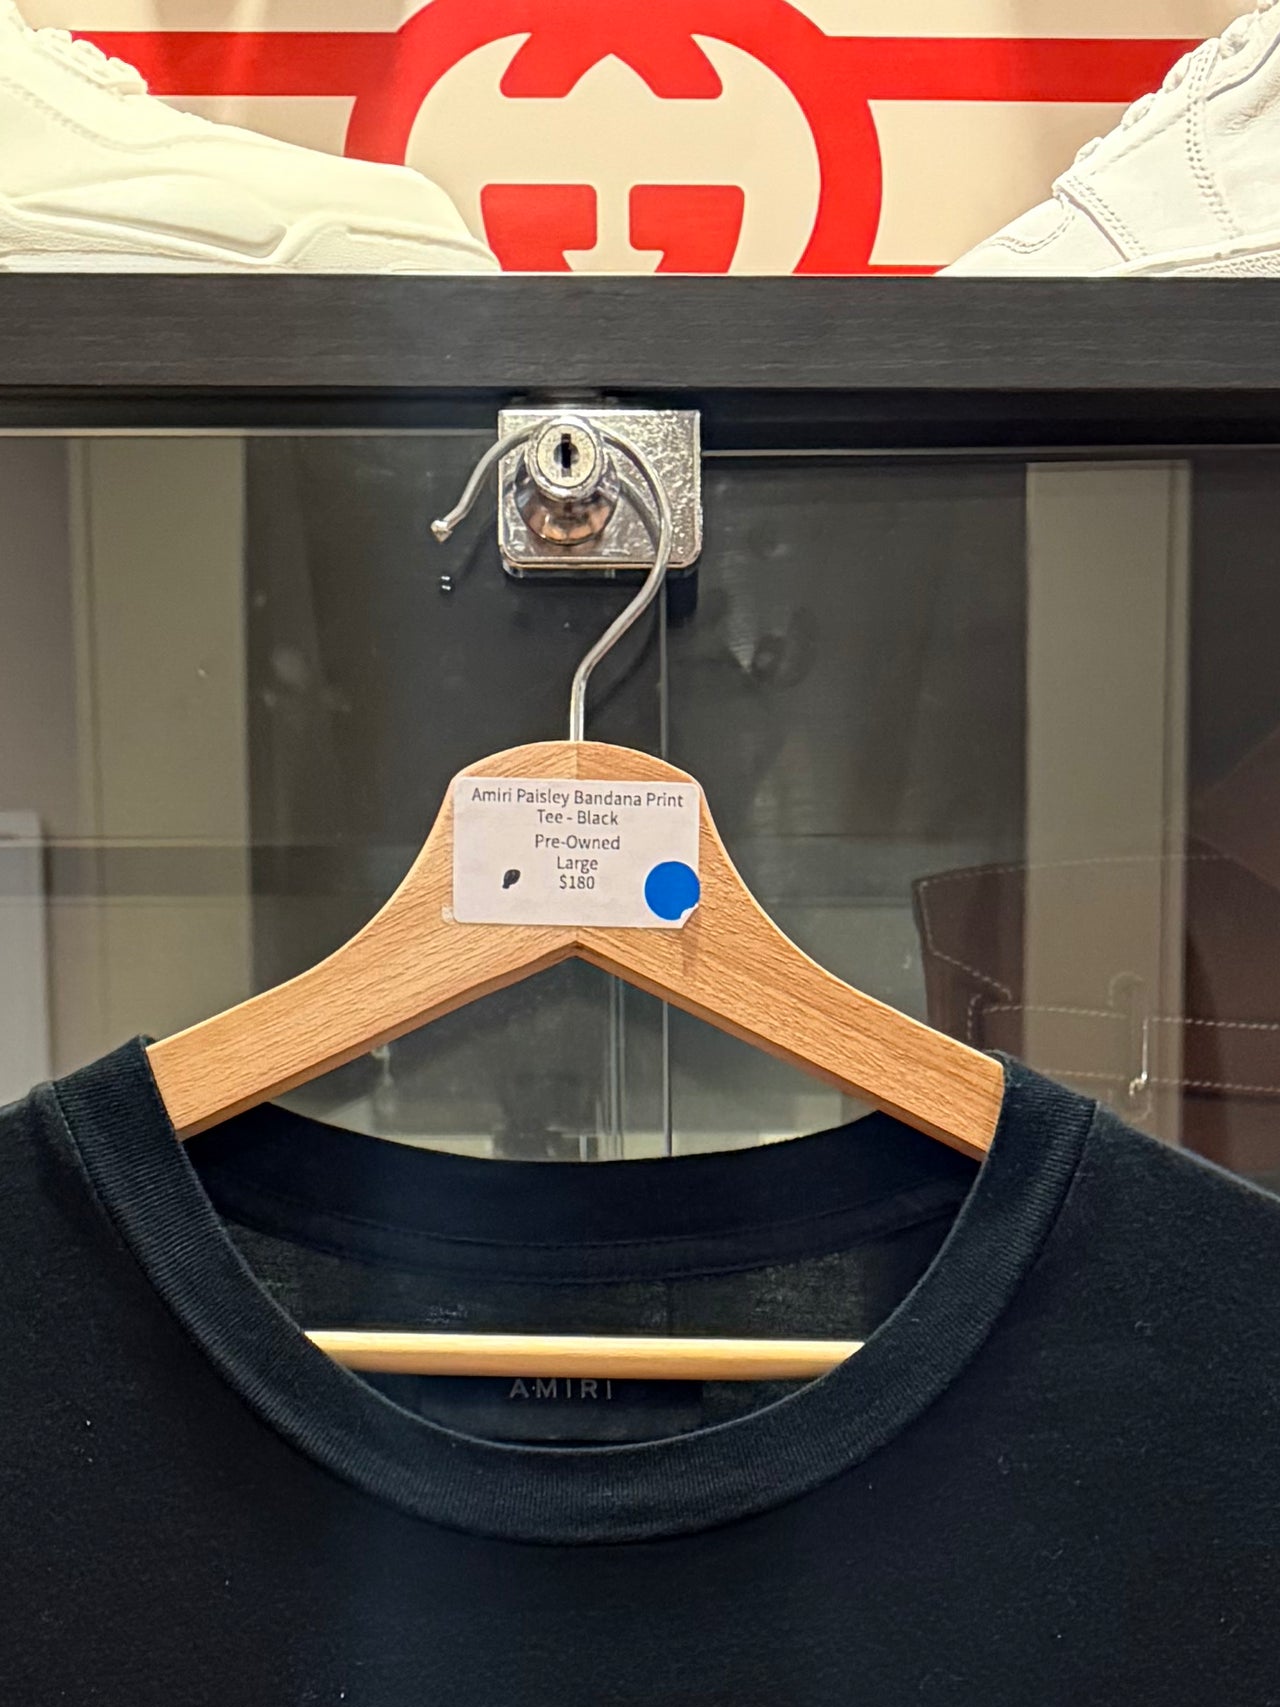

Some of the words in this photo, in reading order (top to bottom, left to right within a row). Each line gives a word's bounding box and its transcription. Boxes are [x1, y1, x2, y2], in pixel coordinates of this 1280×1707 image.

[471, 787, 512, 803] Amiri
[516, 788, 569, 809] Paisley
[573, 790, 642, 807] Bandana
[646, 792, 684, 808] Print
[536, 809, 564, 824] Tee
[577, 810, 619, 826] Black
[535, 833, 621, 850] Pre-Owned
[557, 855, 599, 875] Large
[559, 874, 596, 890] $180
[508, 1377, 613, 1400] AMIRI
